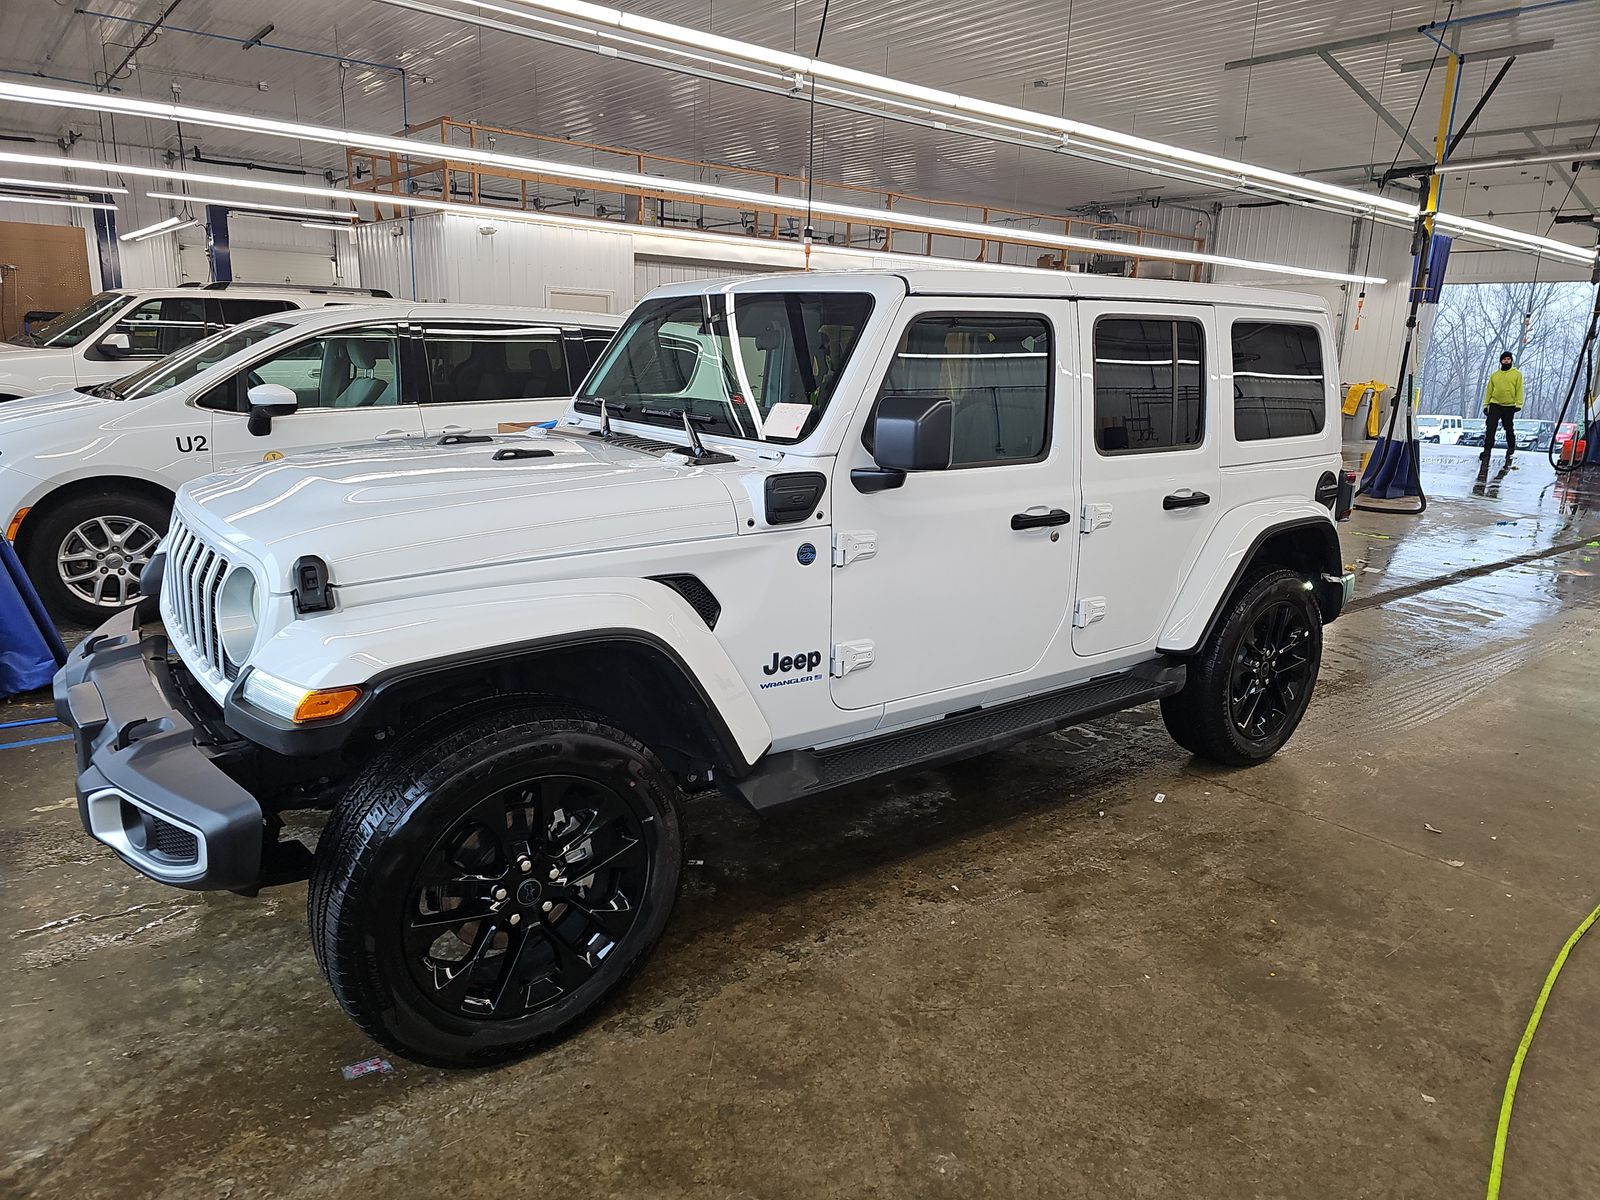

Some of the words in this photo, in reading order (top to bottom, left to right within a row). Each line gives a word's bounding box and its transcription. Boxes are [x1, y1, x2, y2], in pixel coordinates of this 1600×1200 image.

[176, 435, 209, 453] U2
[763, 650, 822, 676] Jeep
[760, 675, 813, 690] WRANGLER
